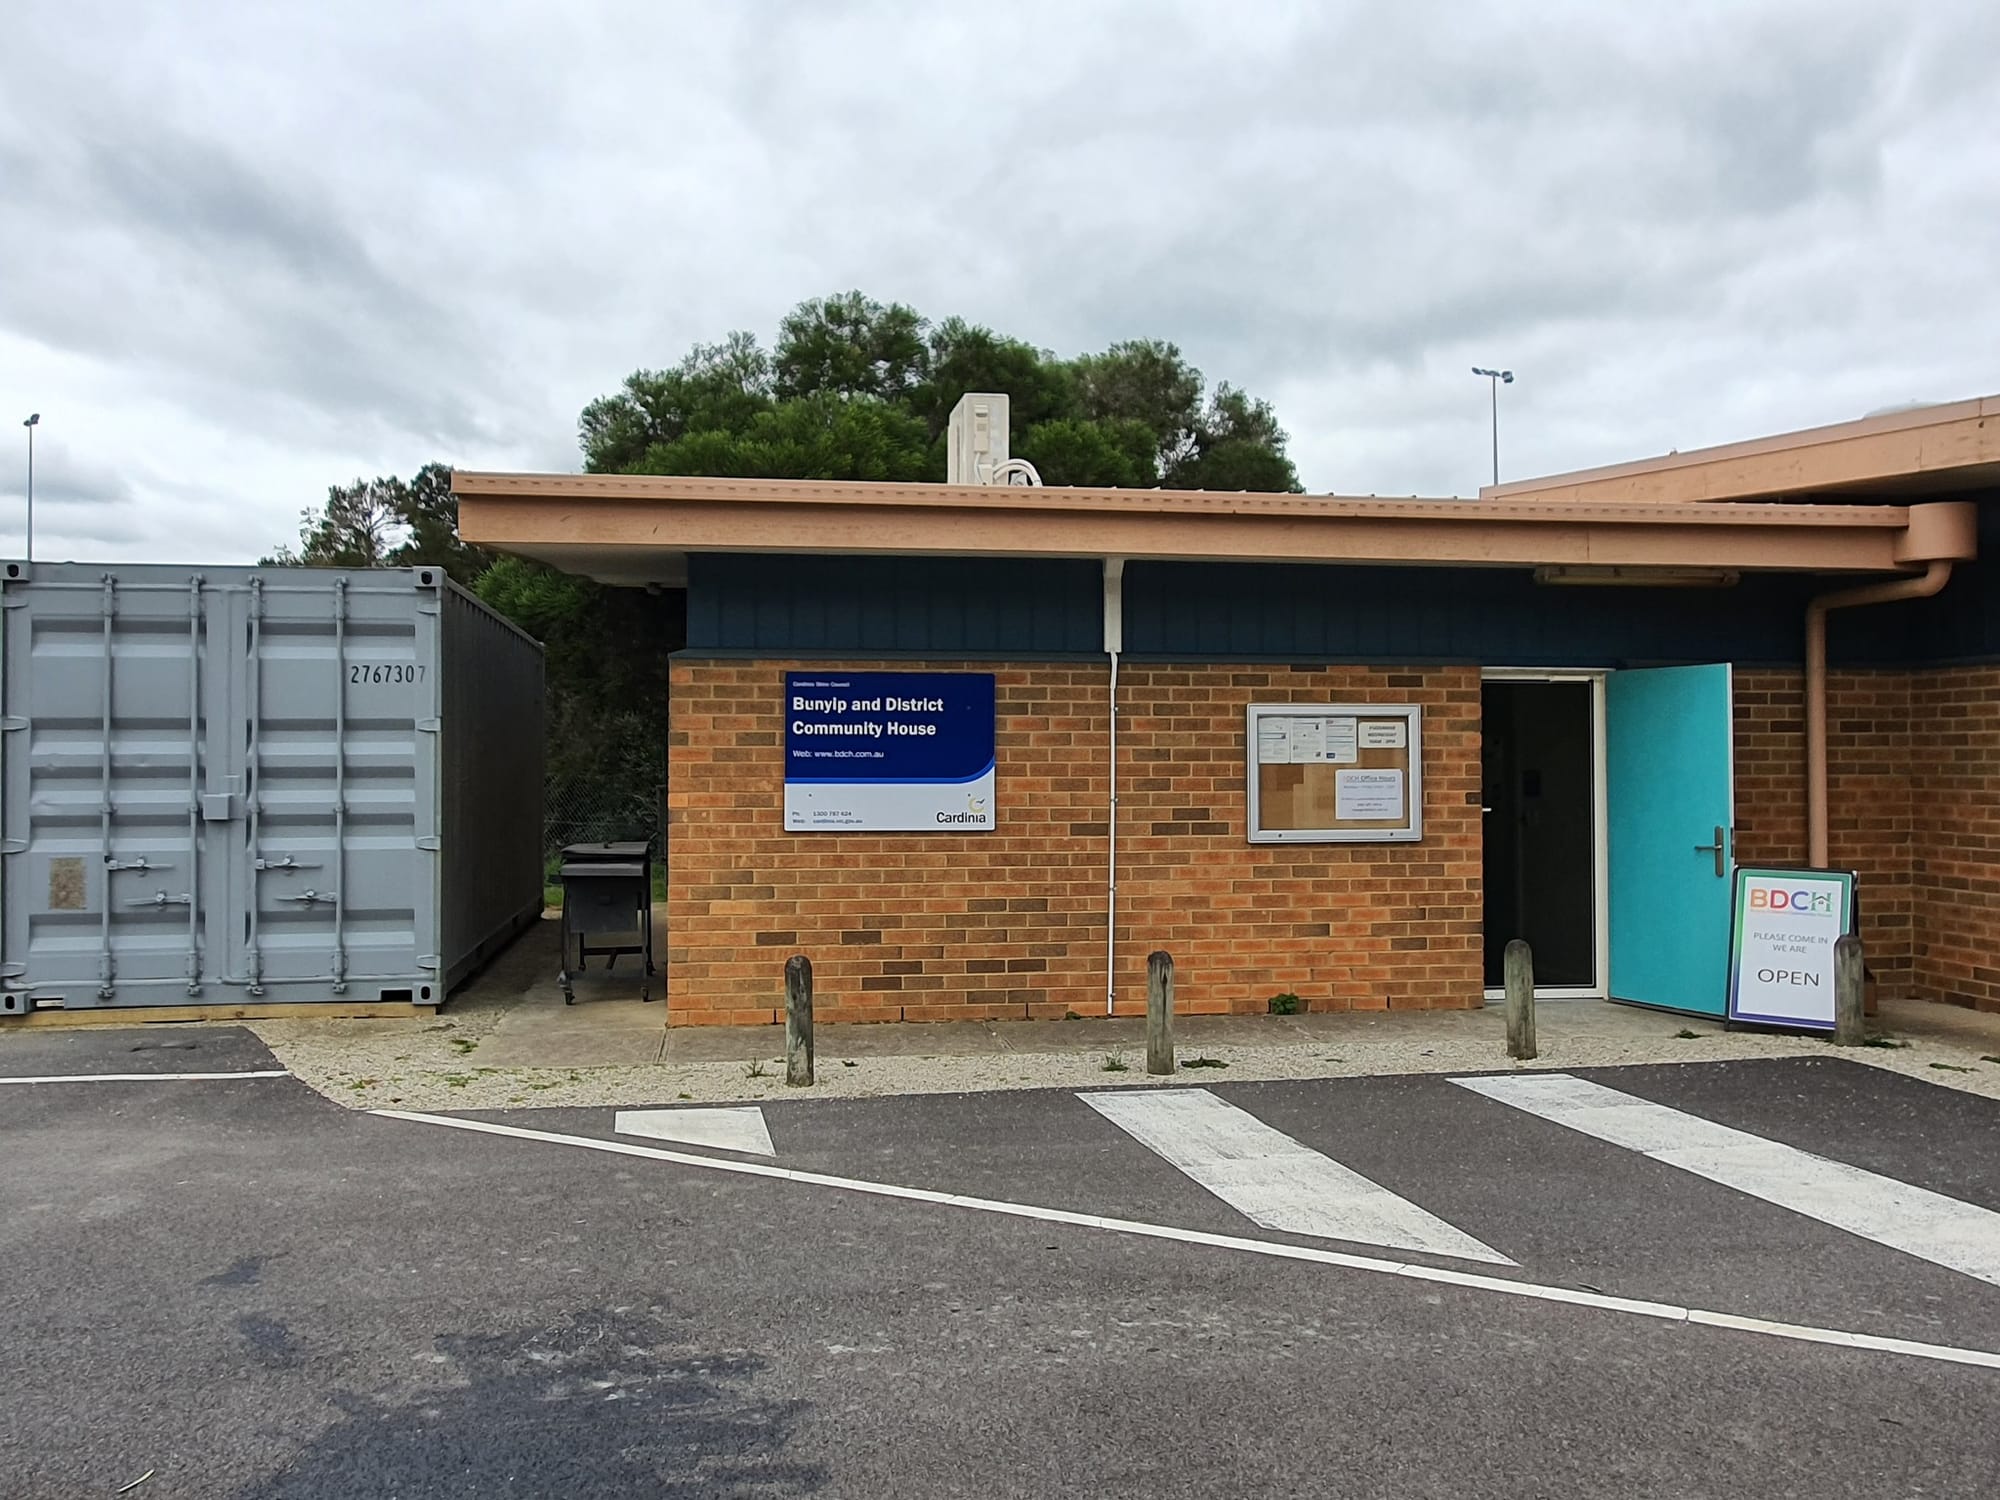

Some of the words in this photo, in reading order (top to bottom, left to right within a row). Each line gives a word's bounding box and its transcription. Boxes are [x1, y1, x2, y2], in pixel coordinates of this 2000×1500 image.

[351, 665, 426, 683] 2767307
[793, 696, 847, 713] Bunyip
[851, 698, 881, 711] and
[885, 697, 944, 711] District
[792, 720, 883, 738] Community
[887, 721, 937, 735] House
[814, 749, 884, 758] www.bdch.com.au
[936, 811, 986, 823] Cardinia
[1750, 888, 1832, 912] BDCH
[1753, 932, 1786, 942] PLEASE
[1788, 934, 1816, 943] COME
[1773, 944, 1787, 952] WE
[1789, 945, 1807, 953] ARE
[1757, 968, 1819, 986] OPEN
